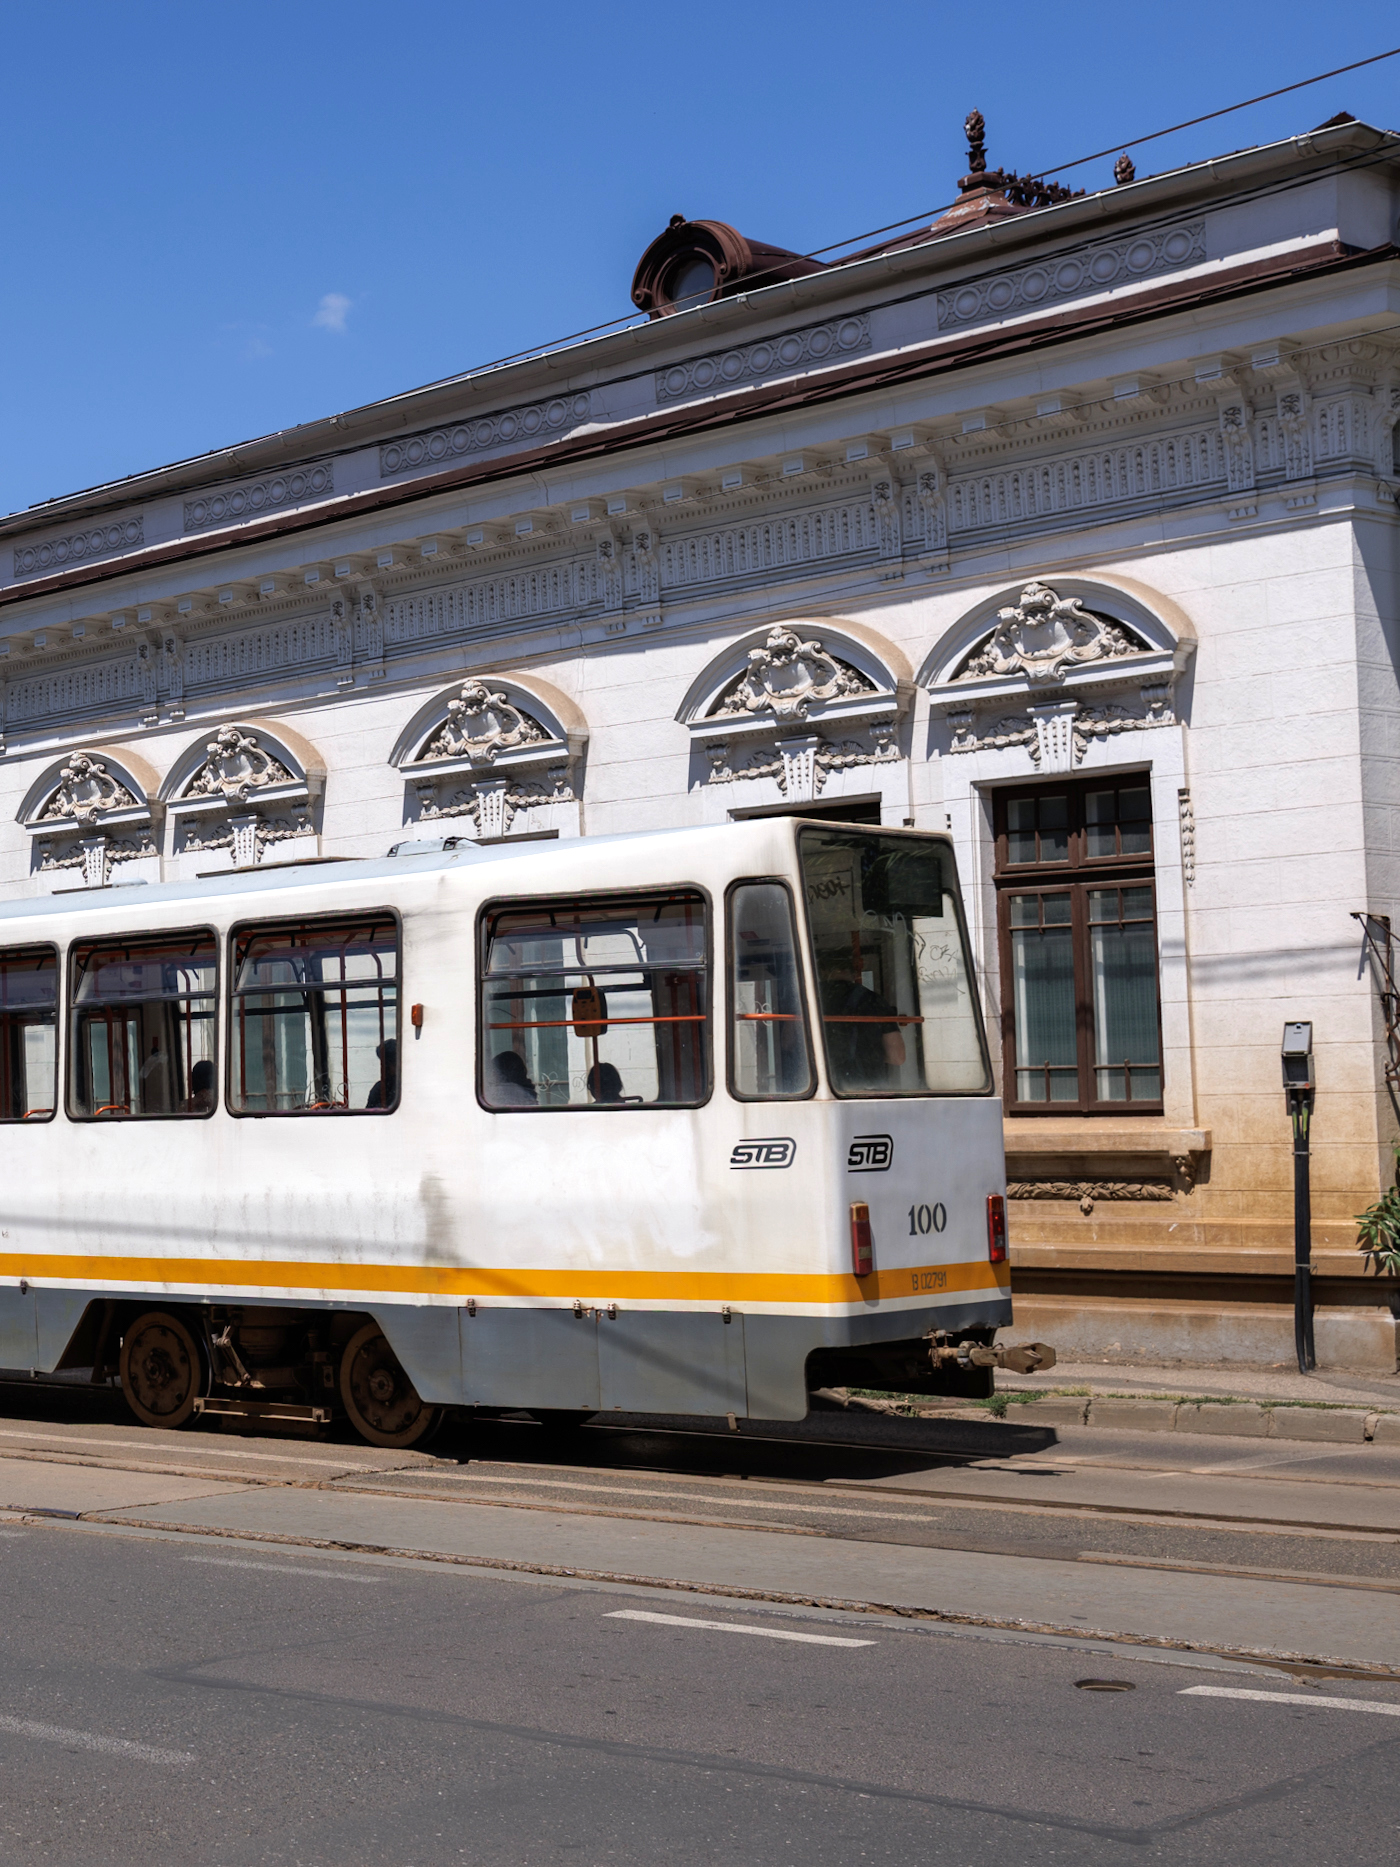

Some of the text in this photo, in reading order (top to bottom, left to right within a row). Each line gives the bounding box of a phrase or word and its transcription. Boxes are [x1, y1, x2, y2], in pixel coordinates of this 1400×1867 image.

[729, 1143, 790, 1165] STB
[847, 1141, 889, 1166] STB
[908, 1202, 948, 1236] 100
[912, 1271, 948, 1291] B 02791
